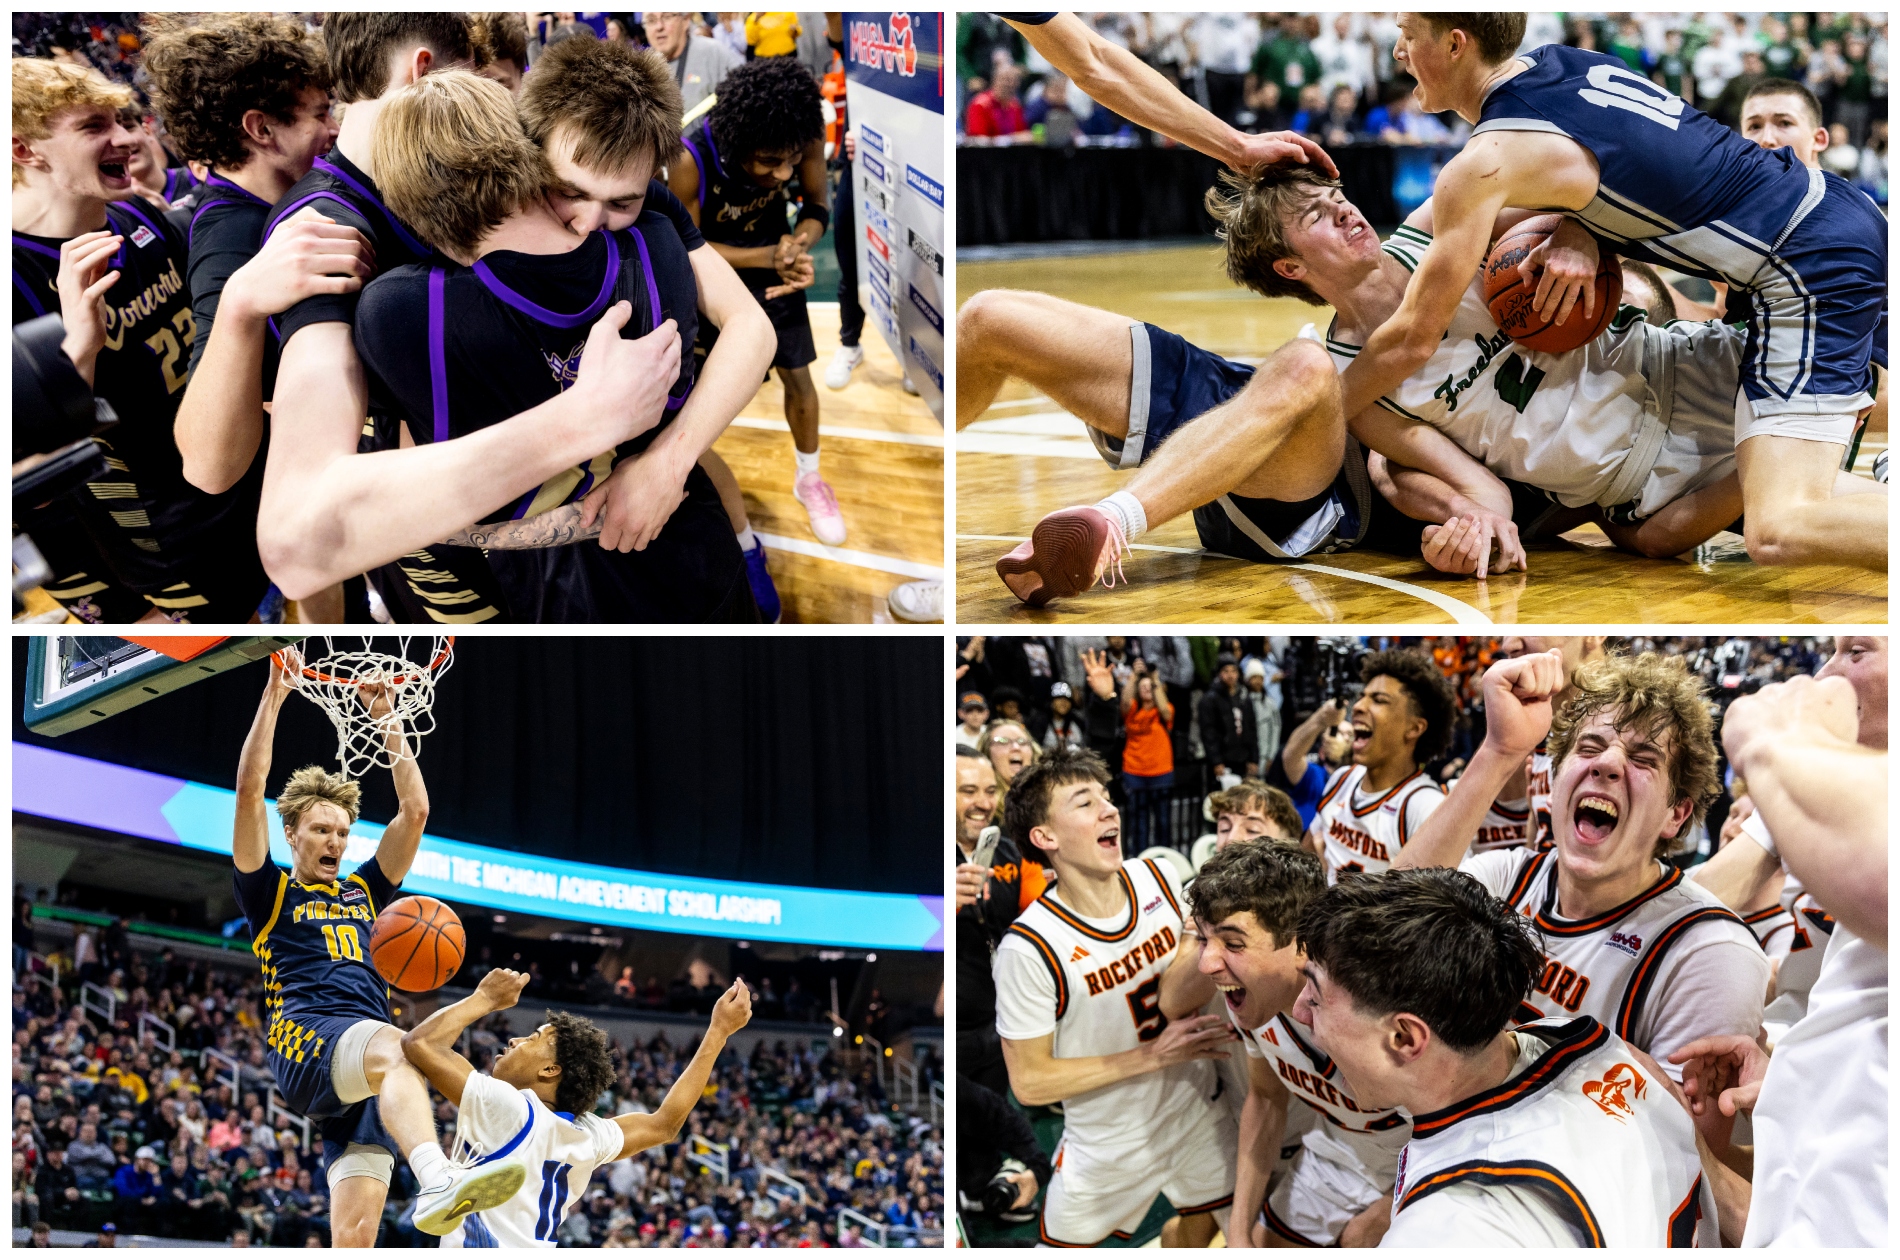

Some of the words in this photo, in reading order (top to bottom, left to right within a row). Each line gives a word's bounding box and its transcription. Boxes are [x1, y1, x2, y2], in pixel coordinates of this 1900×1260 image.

[849, 14, 918, 77] MHSAA
[1577, 63, 1685, 131] 10
[907, 169, 930, 193] DOLLAR
[929, 185, 944, 202] BAY
[104, 257, 183, 351] Concord
[293, 901, 371, 924] PIRATES
[451, 856, 482, 888] THE
[482, 862, 558, 899] MICHIGAN
[558, 876, 667, 914] ACHIEVEMENT
[667, 890, 782, 925] SCHOLARSHIP!
[321, 924, 363, 963] 10
[1083, 925, 1177, 997] ROCKFORD
[1126, 972, 1169, 1043] 5
[1535, 959, 1591, 1013] ORD
[1275, 1055, 1392, 1114] ROCKFO
[535, 1160, 574, 1242] 11
